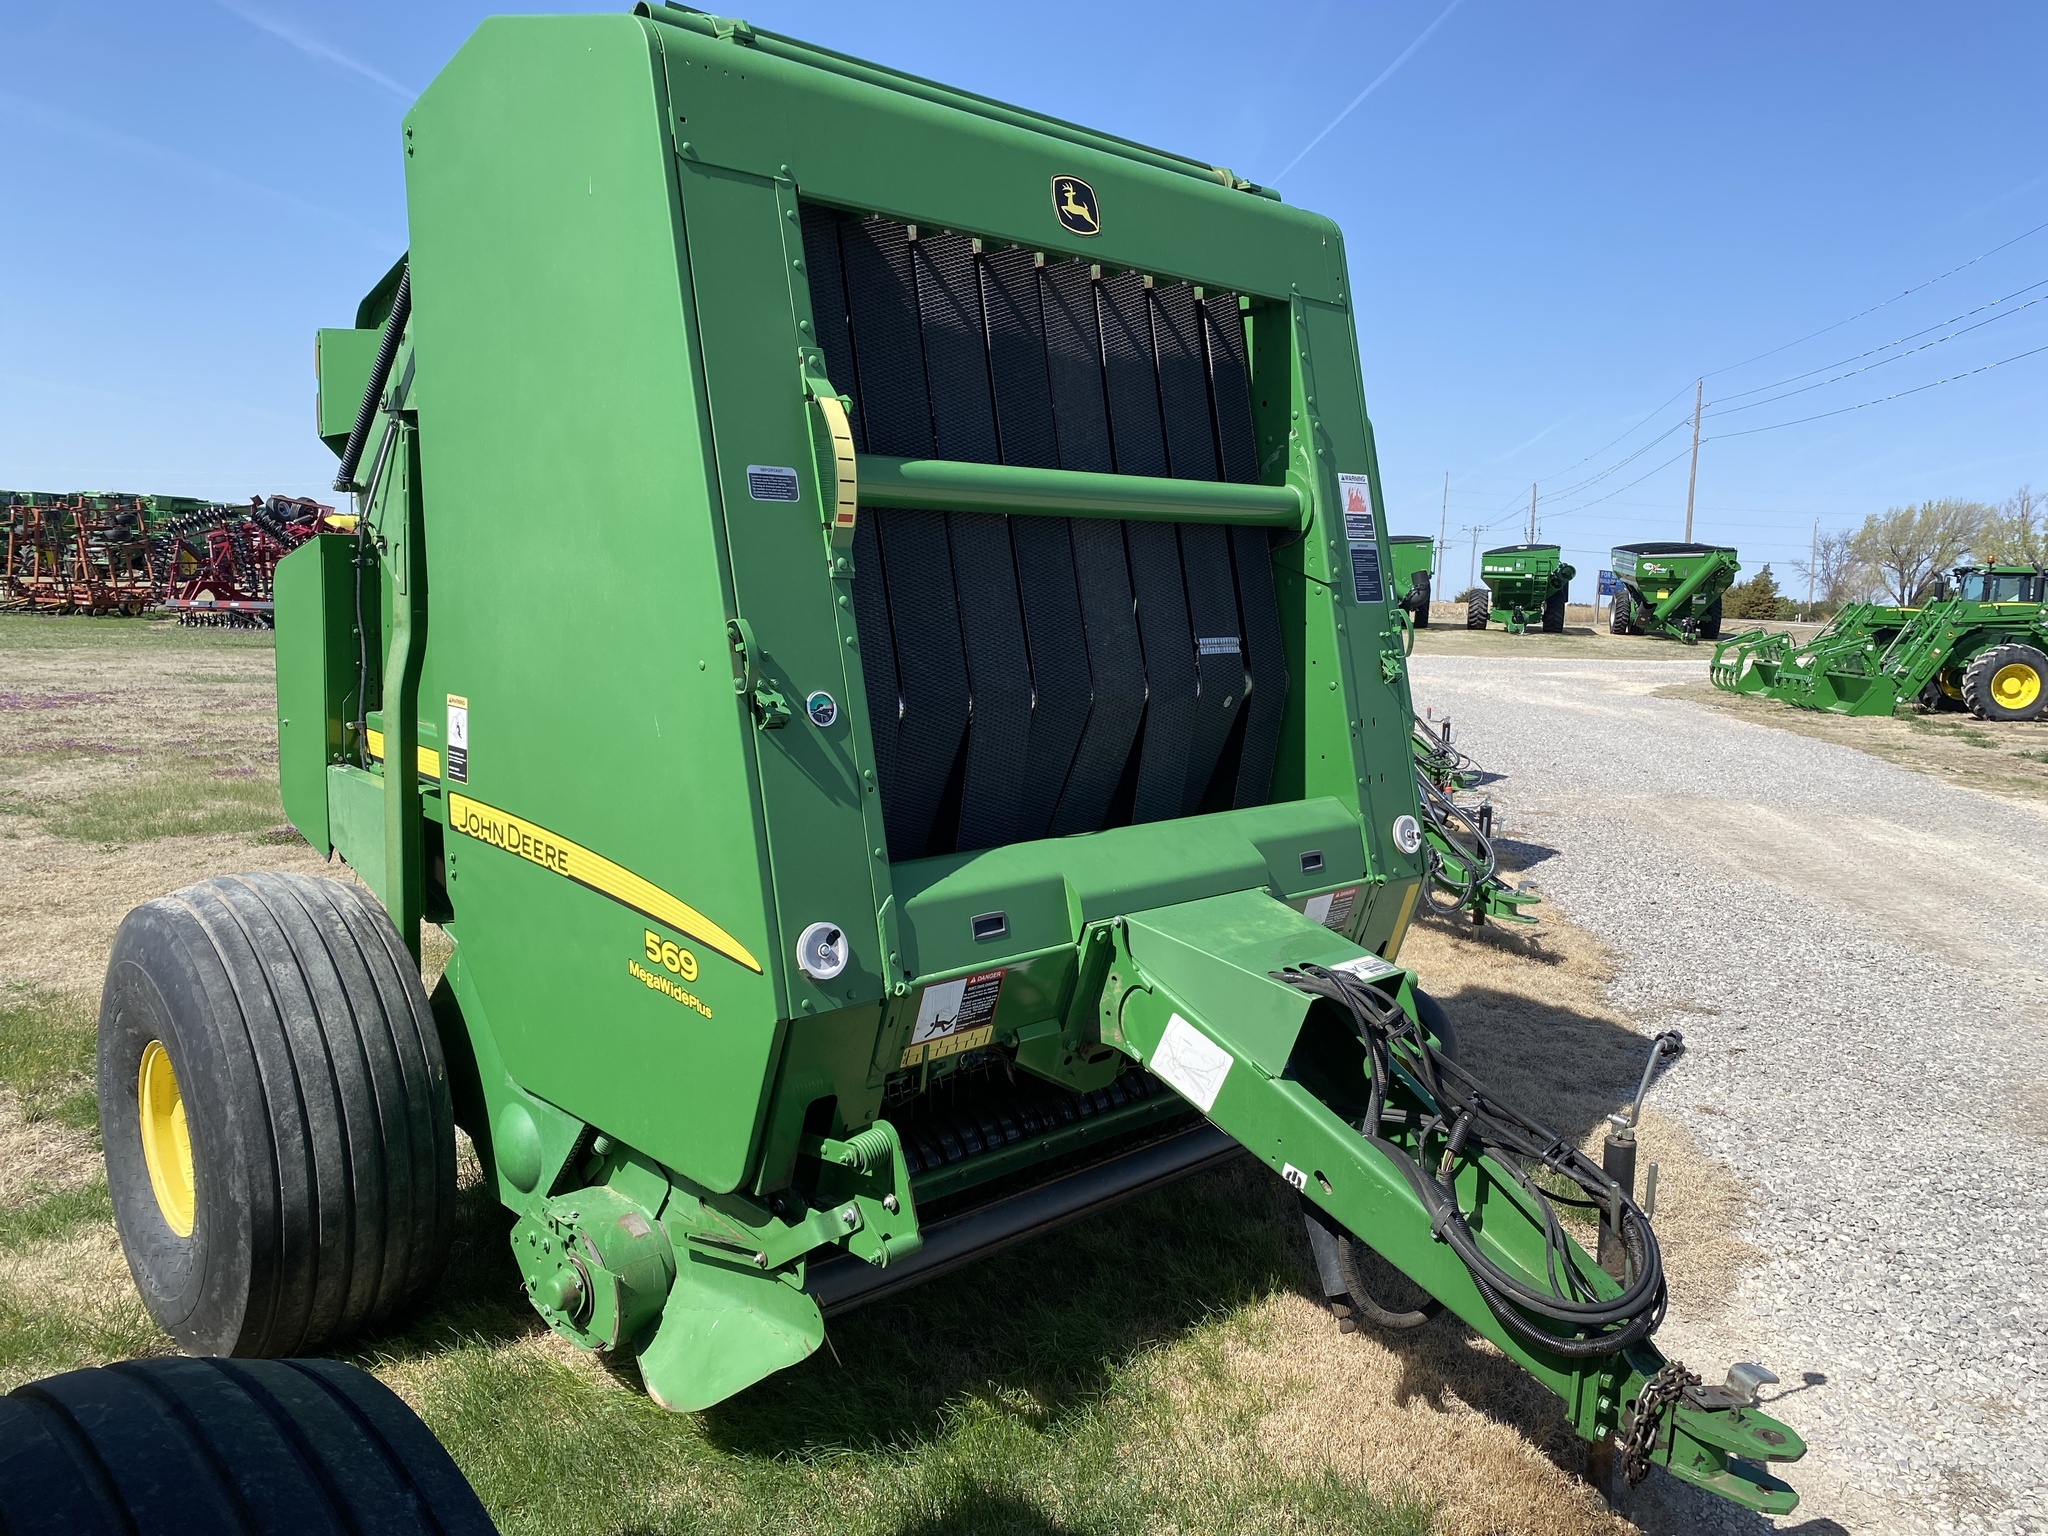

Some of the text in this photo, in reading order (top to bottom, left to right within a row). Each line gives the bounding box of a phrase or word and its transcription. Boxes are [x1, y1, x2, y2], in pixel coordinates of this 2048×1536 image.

[459, 806, 569, 873] JOHN DEERE
[1339, 889, 1356, 897] DANGER
[644, 927, 699, 982] 569
[976, 971, 1001, 982] DANGER
[628, 958, 712, 1020] MegaWidePlus
